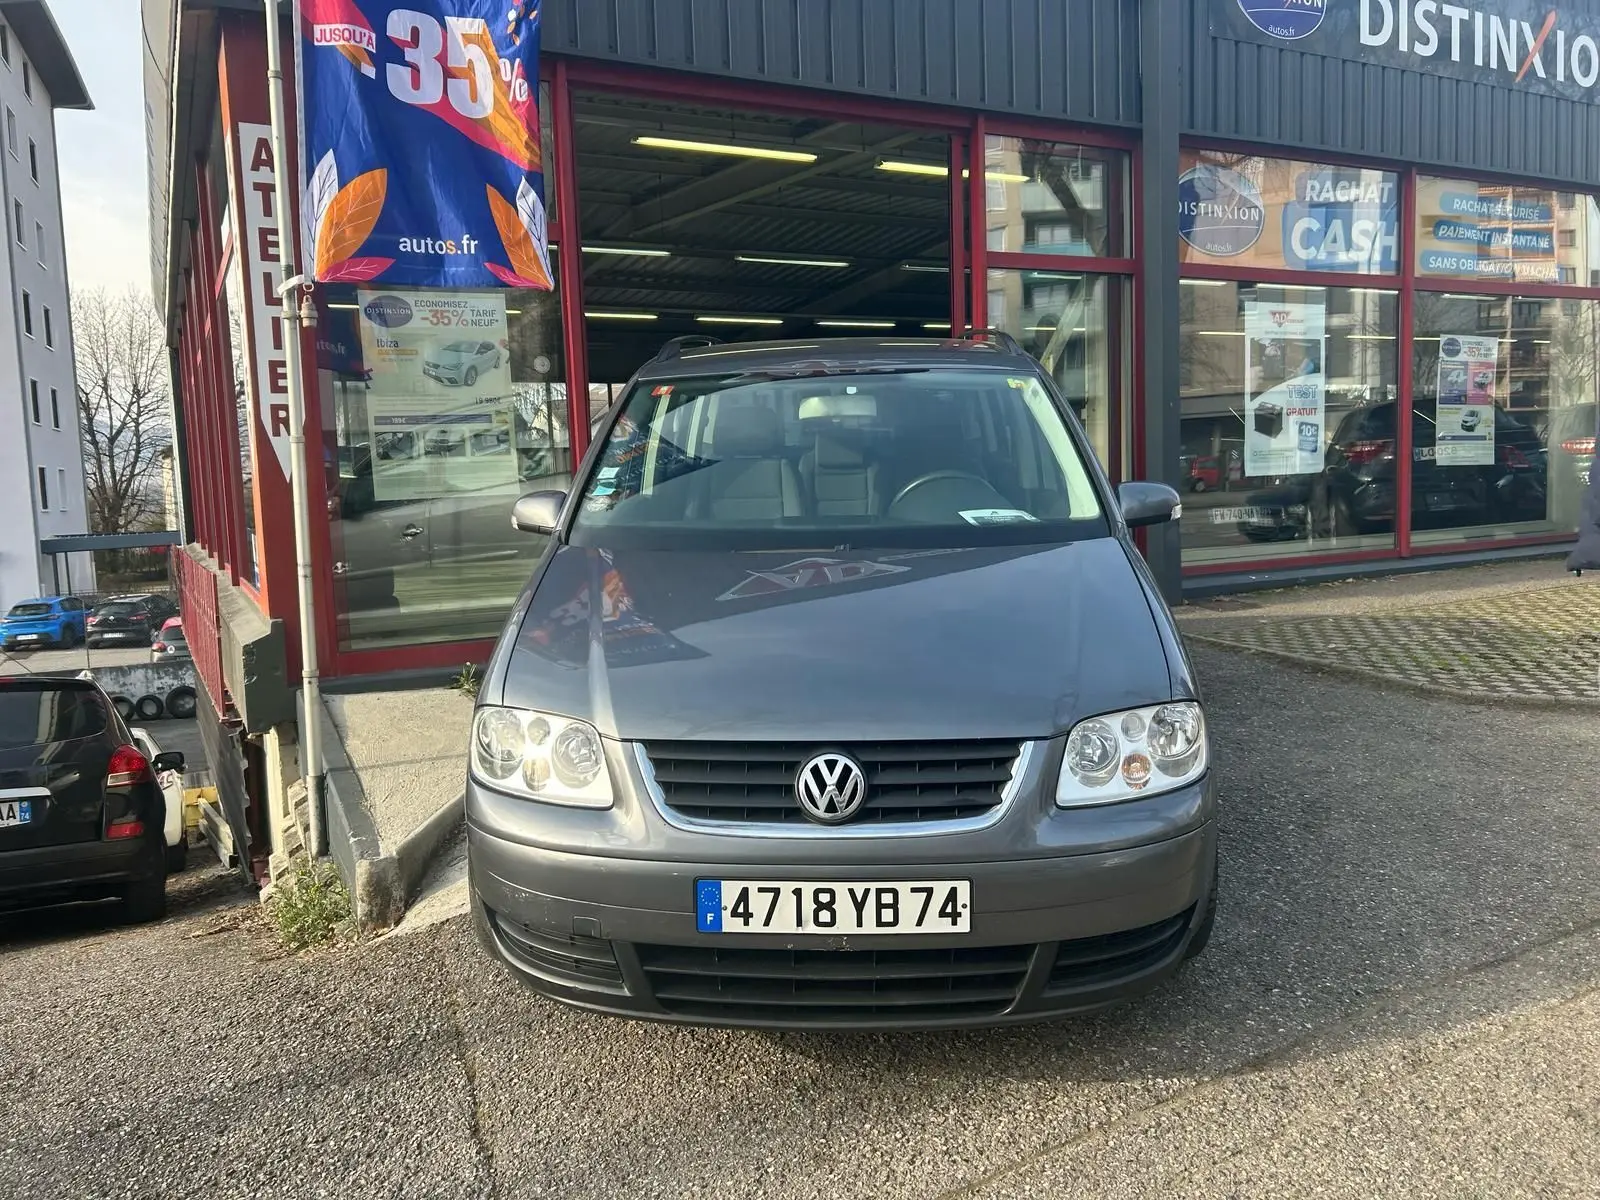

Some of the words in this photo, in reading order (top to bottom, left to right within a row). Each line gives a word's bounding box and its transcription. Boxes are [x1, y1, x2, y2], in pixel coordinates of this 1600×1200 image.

[315, 27, 375, 50] JUSQU'À
[1268, 25, 1295, 36] autos.fr
[1305, 179, 1393, 204] RACHAT
[1453, 199, 1494, 216] RACHAT
[398, 234, 479, 255] autos.fr
[1291, 217, 1398, 262] CASH
[1438, 225, 1490, 243] PAIEMENT
[1491, 231, 1550, 249] INSTANTANÉ
[1428, 255, 1457, 270] SANS
[250, 137, 291, 437] ATELIER
[420, 309, 469, 327] -35%
[470, 309, 497, 317] TARIF
[376, 338, 399, 348] Ibiza
[1287, 385, 1318, 399] TEST
[1286, 408, 1318, 417] GRATUIT
[20, 812, 30, 821] 74
[730, 886, 838, 928] 4718
[847, 887, 900, 928] YB
[910, 886, 963, 927] 74
[706, 912, 715, 925] F
